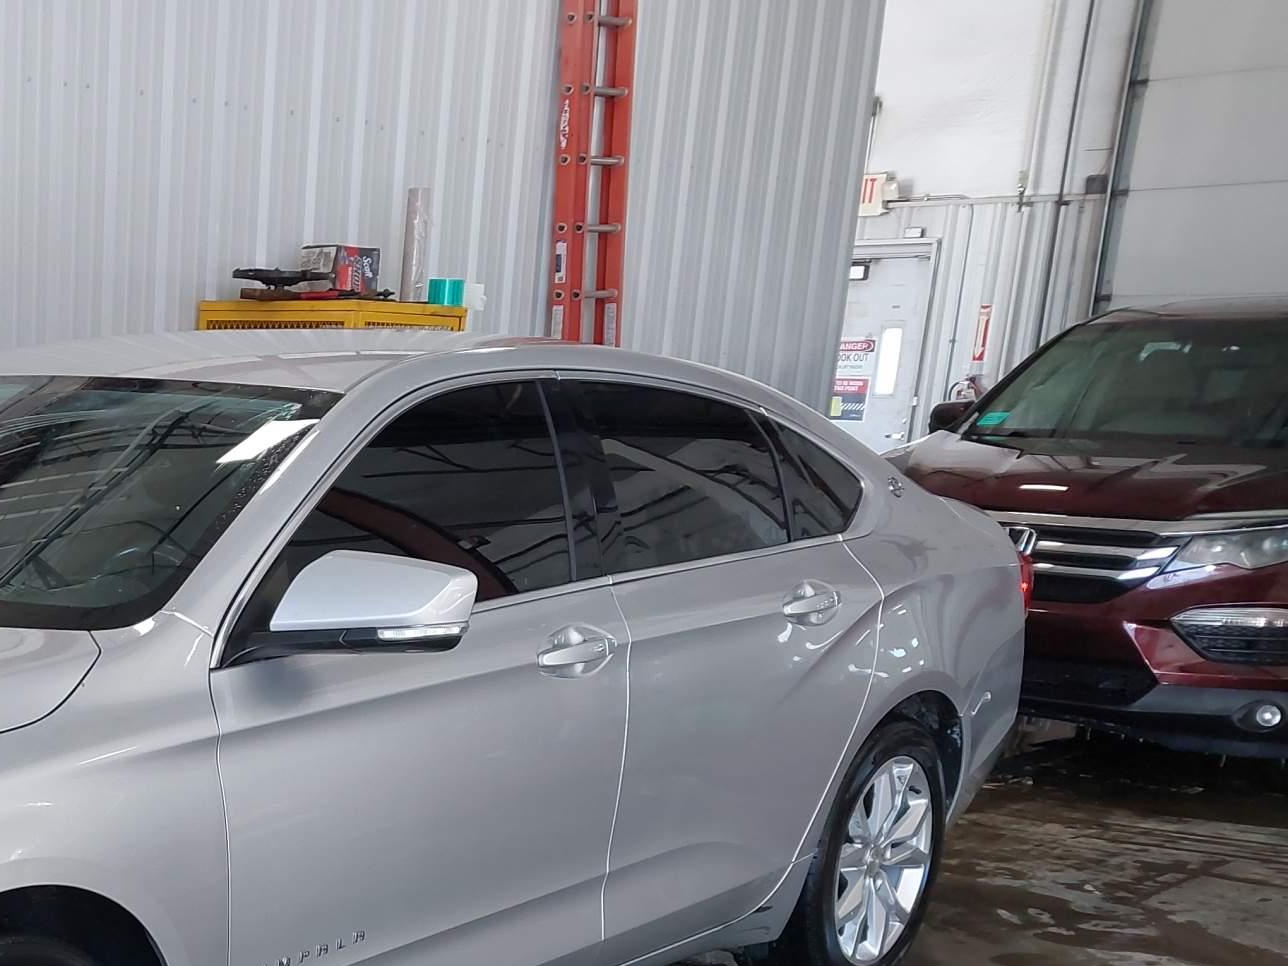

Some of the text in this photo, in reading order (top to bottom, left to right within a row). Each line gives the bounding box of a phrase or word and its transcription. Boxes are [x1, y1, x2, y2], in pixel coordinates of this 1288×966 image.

[862, 178, 878, 204] IT
[840, 342, 869, 350] ANGER
[837, 353, 869, 361] OOK OUT
